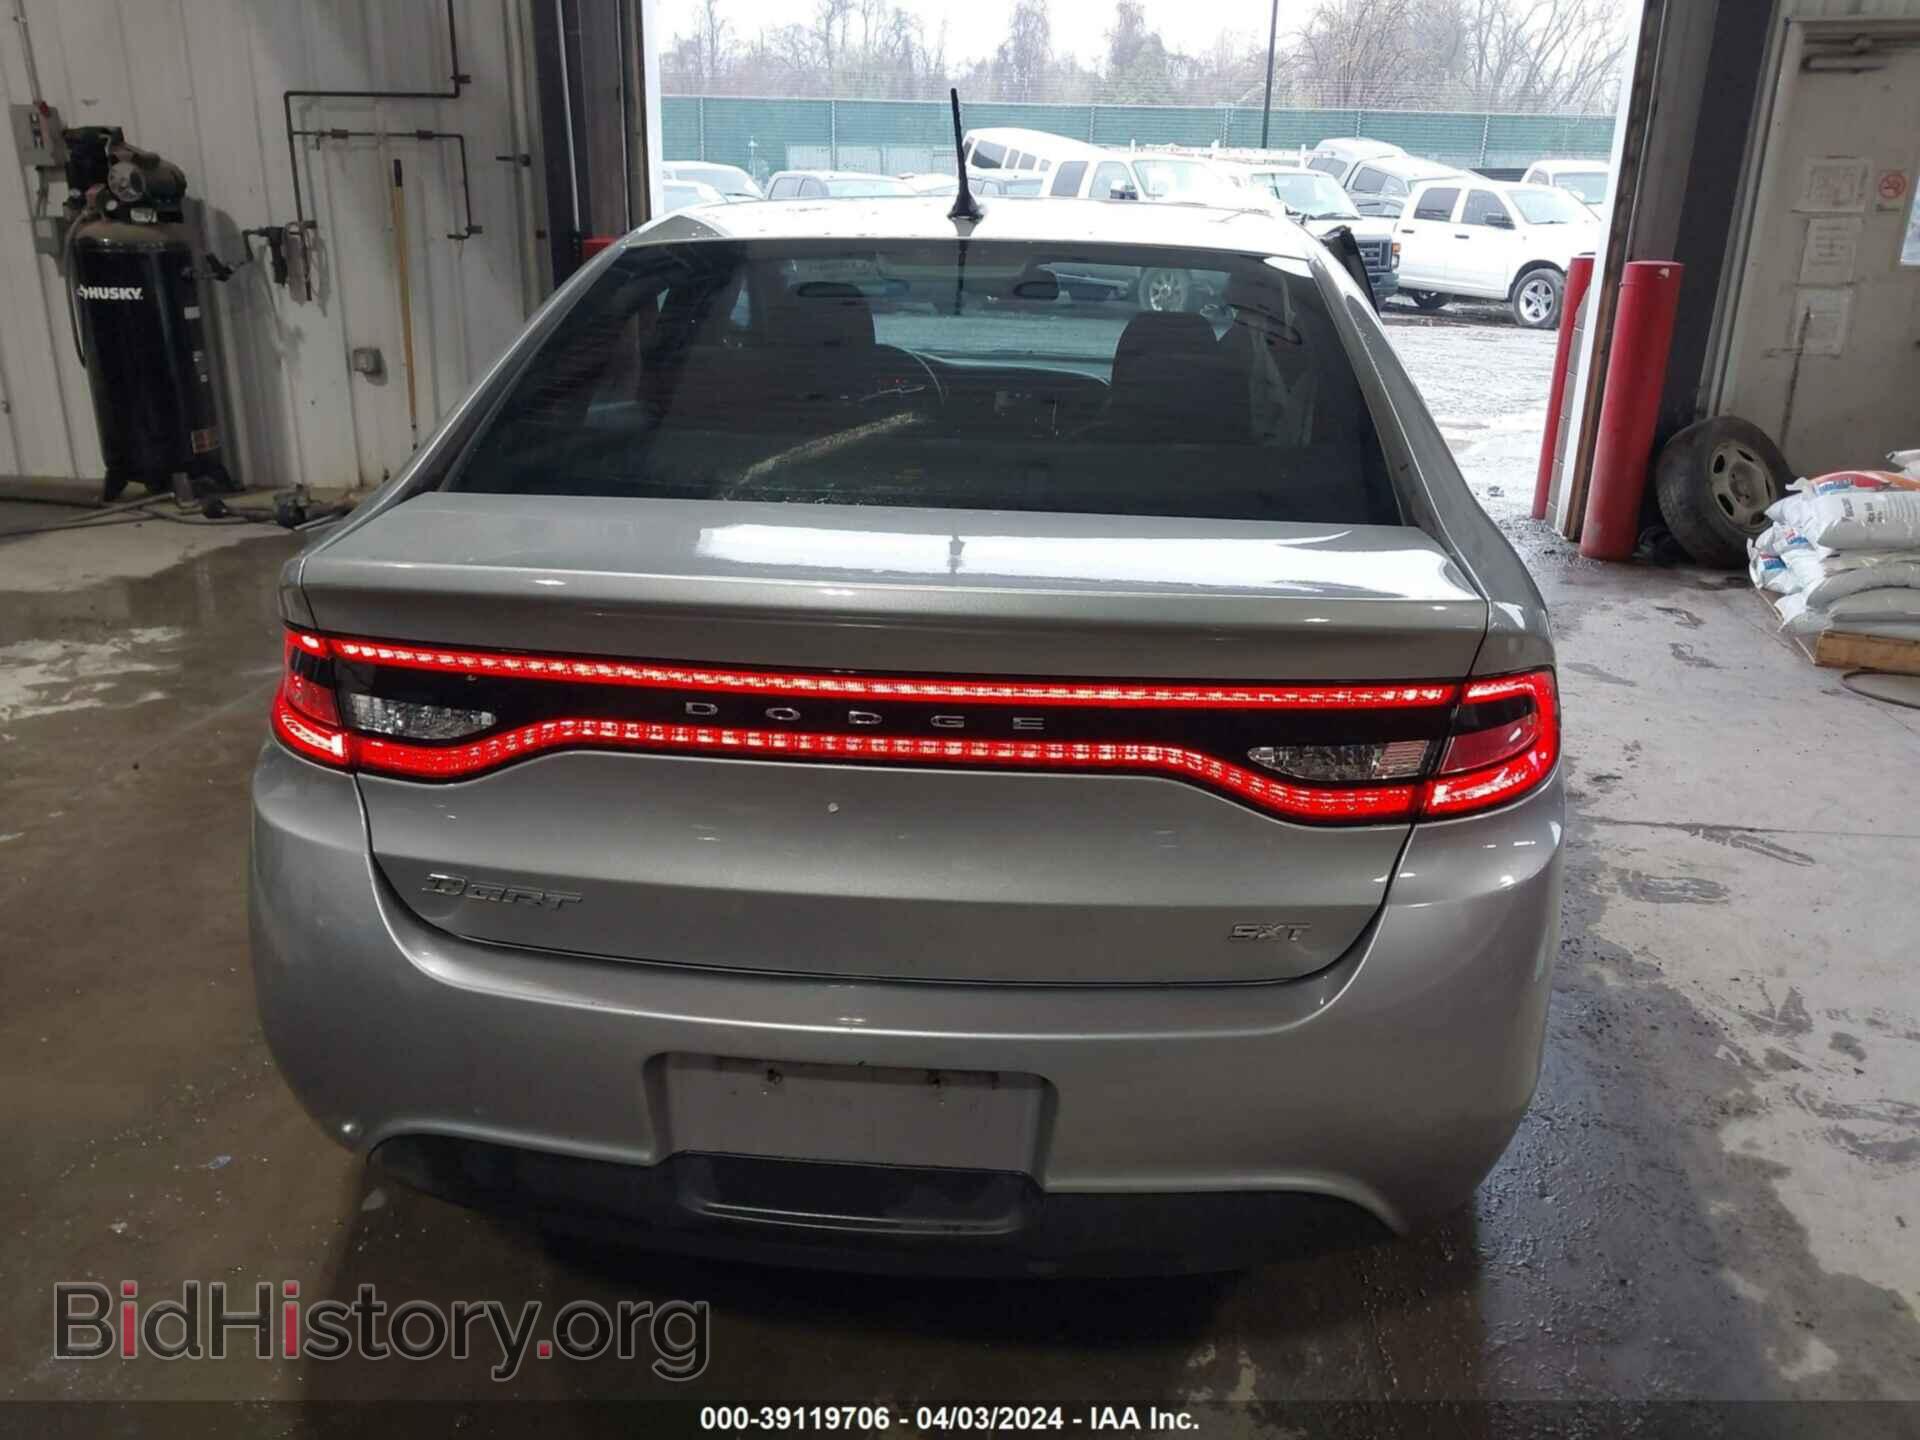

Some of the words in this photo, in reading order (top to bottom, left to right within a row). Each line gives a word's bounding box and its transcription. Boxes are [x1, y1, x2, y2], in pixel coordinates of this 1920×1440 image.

[87, 286, 142, 300] HUSKY
[684, 701, 1045, 731] DODGE
[1228, 923, 1312, 942] SXT
